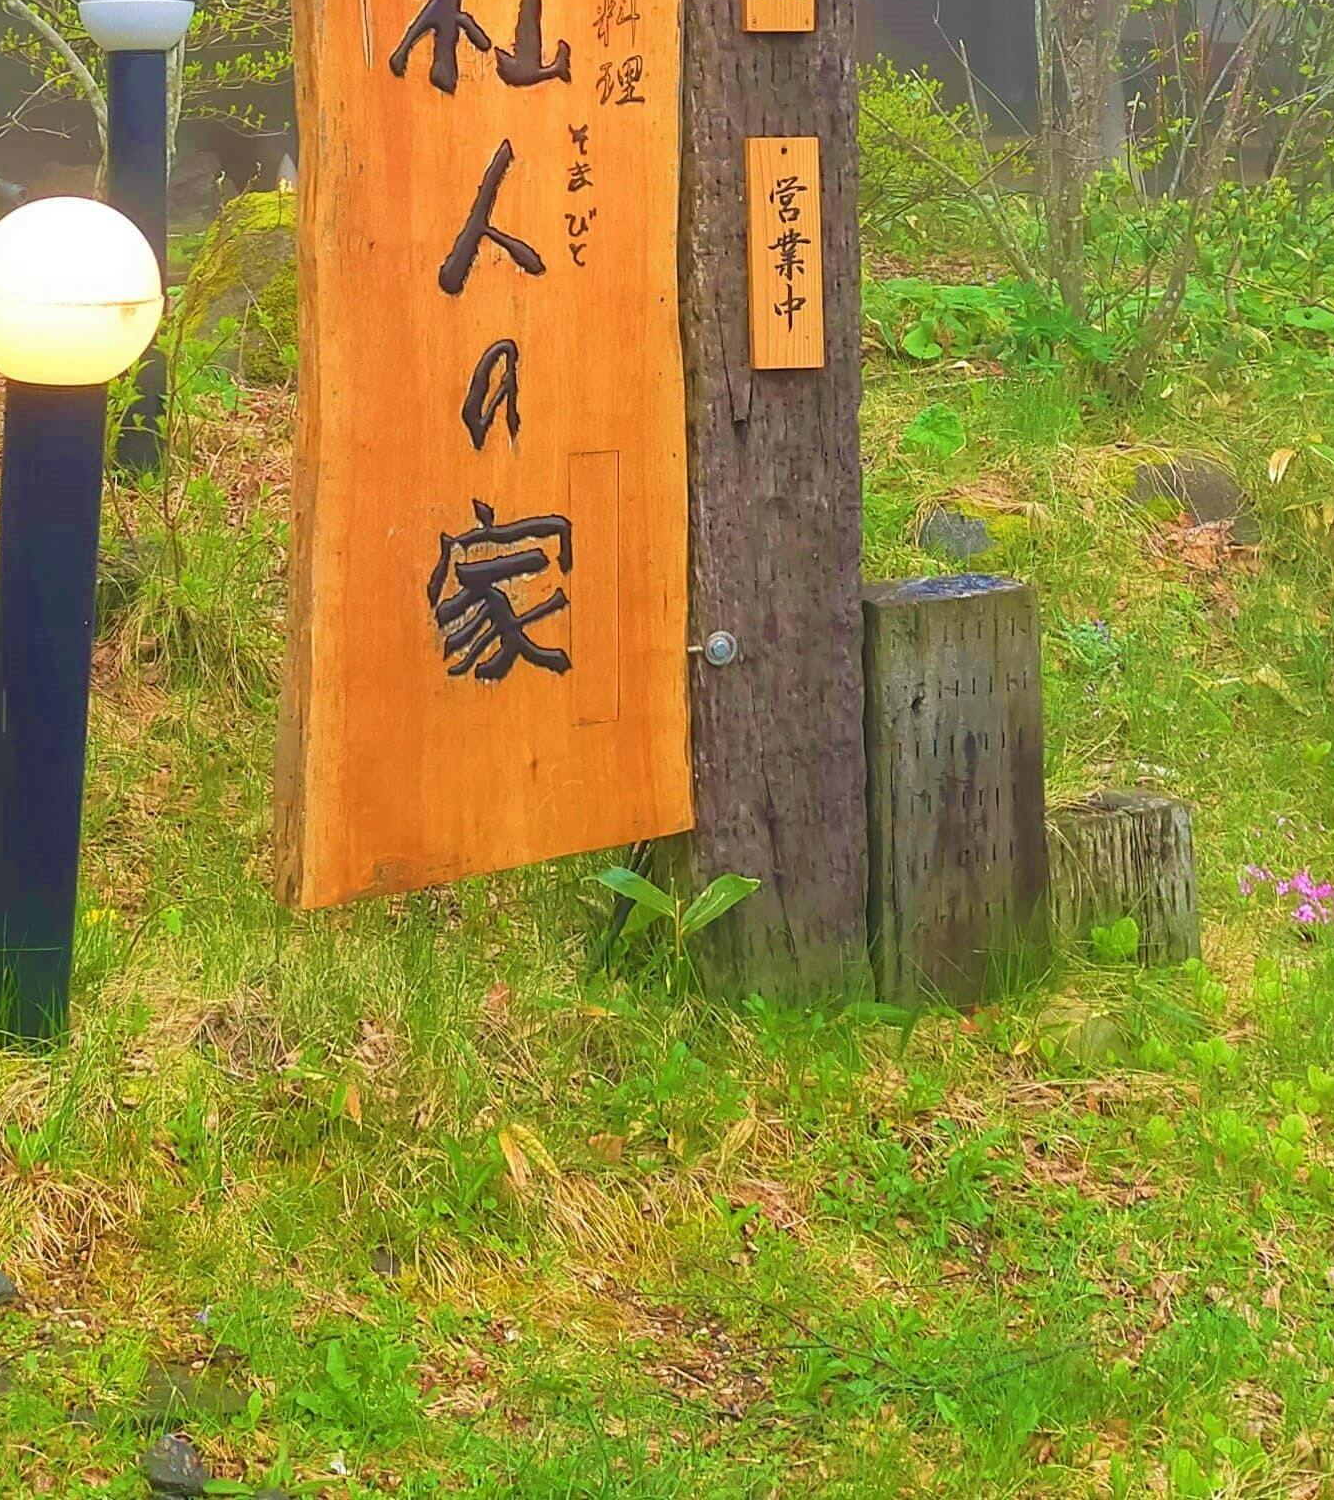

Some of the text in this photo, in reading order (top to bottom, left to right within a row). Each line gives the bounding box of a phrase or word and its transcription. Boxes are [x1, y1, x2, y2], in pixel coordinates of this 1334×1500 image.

[565, 123, 597, 267] そまびと
[768, 175, 811, 333] 営業中
